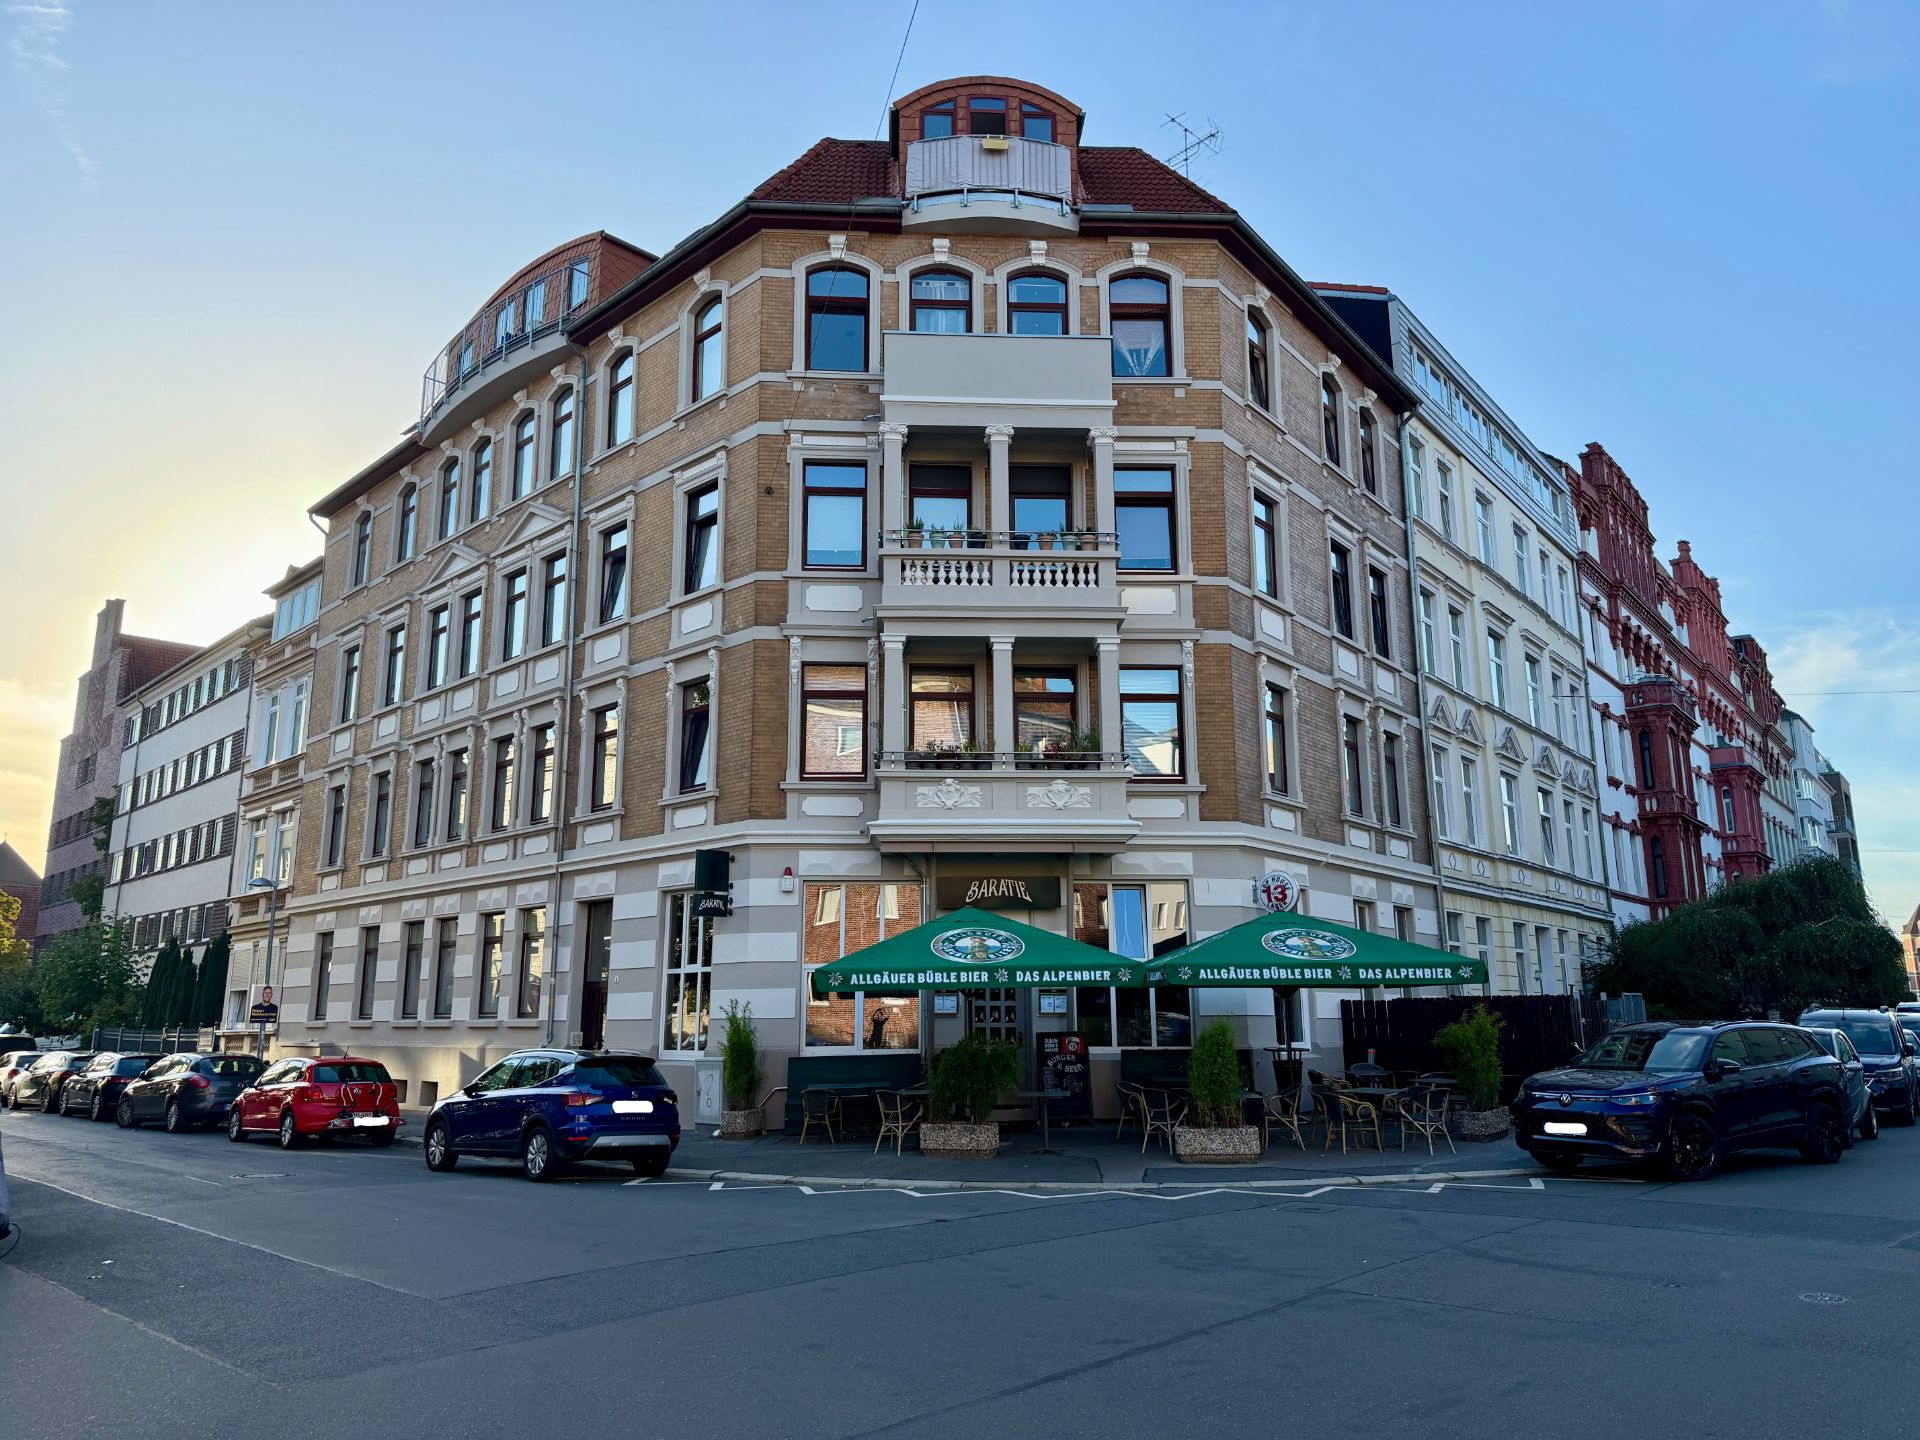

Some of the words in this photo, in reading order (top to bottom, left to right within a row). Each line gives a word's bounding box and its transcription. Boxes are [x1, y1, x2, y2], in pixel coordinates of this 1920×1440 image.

[965, 878, 1033, 902] BARATIE
[1266, 885, 1288, 903] 13
[850, 971, 915, 985] ALLGÄUER
[917, 970, 958, 984] BÜBLE
[960, 971, 989, 983] BIER
[1016, 971, 1040, 982] DAS
[1043, 970, 1111, 982] ALPENBIER
[1199, 966, 1261, 980] ALLGÄUER
[1263, 966, 1301, 980] BÜBLE
[1303, 968, 1333, 980] BIER
[1358, 968, 1383, 980] DAS
[1385, 968, 1453, 980] ALPENBIER
[1047, 1054, 1076, 1067] BURGER
[1064, 1063, 1085, 1073] BEER
